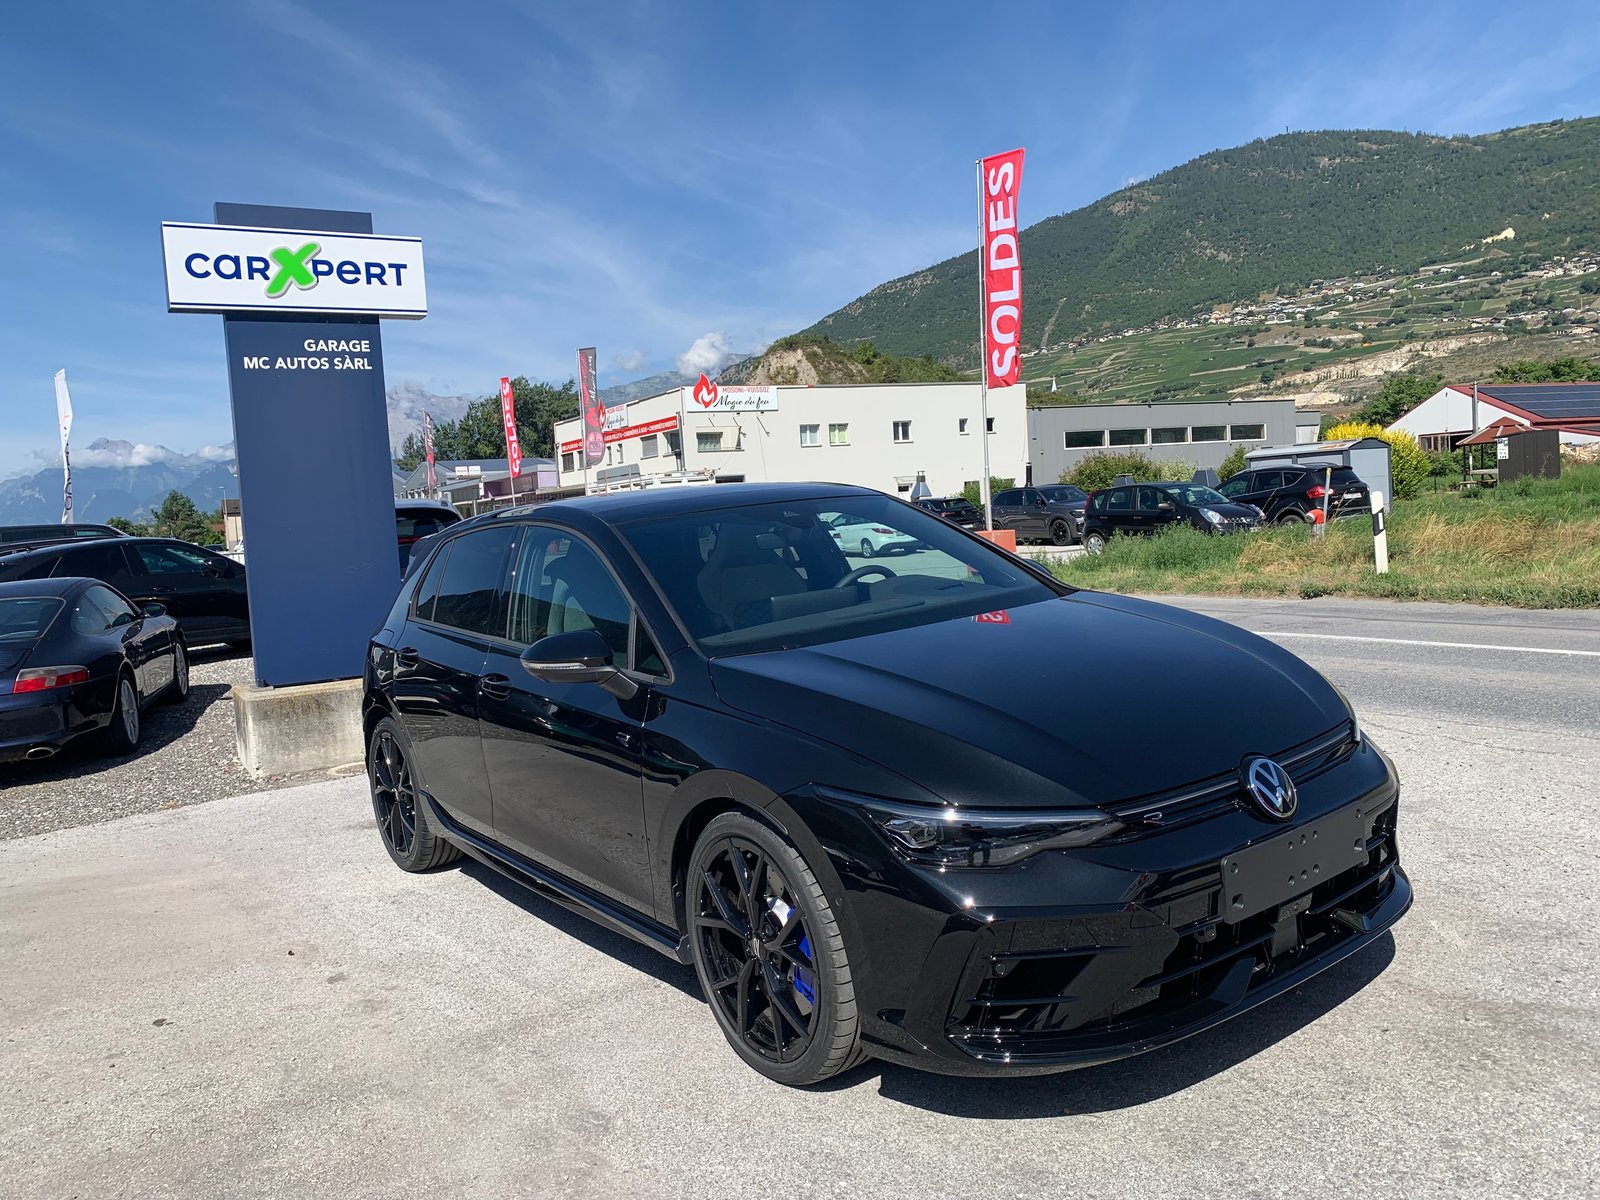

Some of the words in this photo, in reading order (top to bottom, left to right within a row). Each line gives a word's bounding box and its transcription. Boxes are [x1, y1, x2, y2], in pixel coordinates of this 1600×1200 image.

[988, 161, 1020, 378] SOLDES
[304, 339, 371, 352] GARAGE
[243, 356, 271, 370] MC
[275, 356, 330, 370] AUTOS
[333, 354, 373, 371] SÀRL
[713, 394, 742, 410] Magie
[744, 396, 755, 406] du
[756, 396, 769, 409] feu
[502, 381, 521, 473] SOLDES
